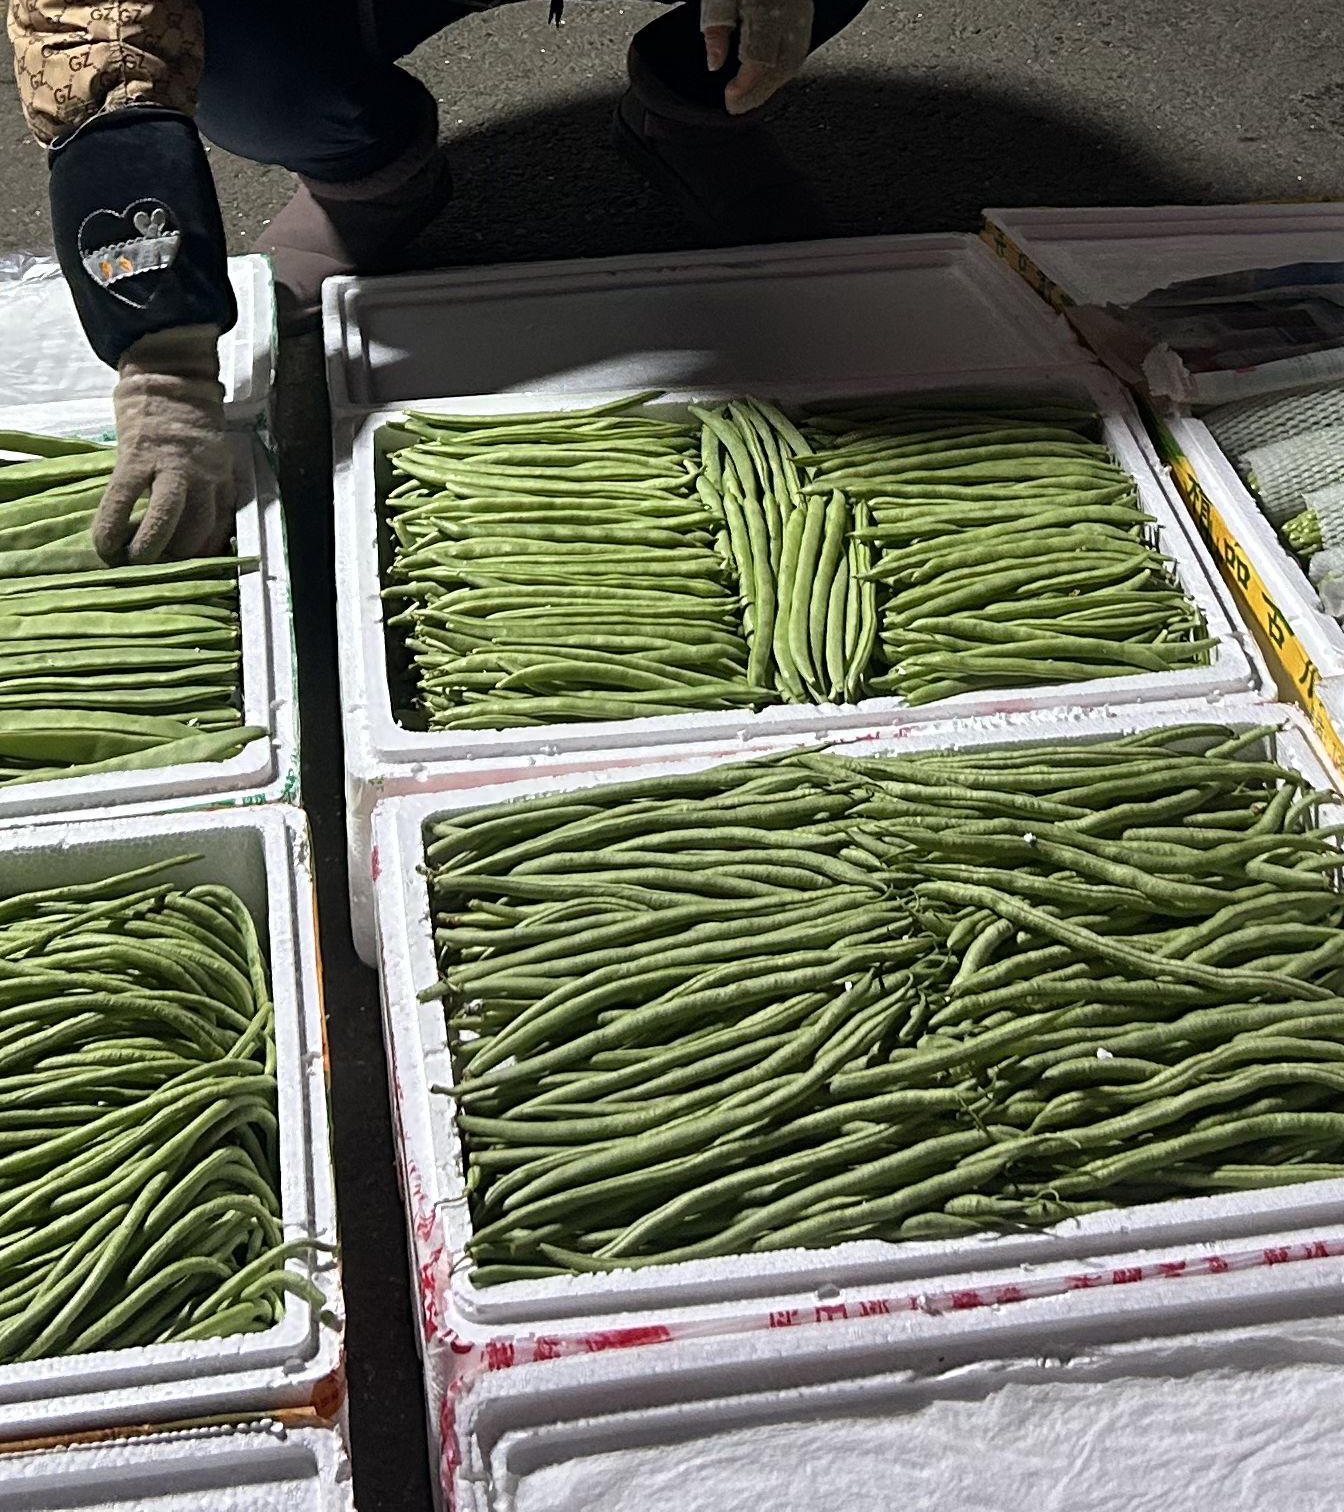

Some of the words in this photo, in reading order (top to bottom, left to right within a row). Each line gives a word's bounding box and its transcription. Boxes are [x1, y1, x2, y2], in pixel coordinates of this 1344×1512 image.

[91, 7, 114, 22] GZ
[119, 9, 143, 23] GZ
[69, 52, 94, 72] GZ
[124, 54, 148, 70] GZ
[30, 71, 46, 89] GZ
[54, 85, 77, 104] GZ
